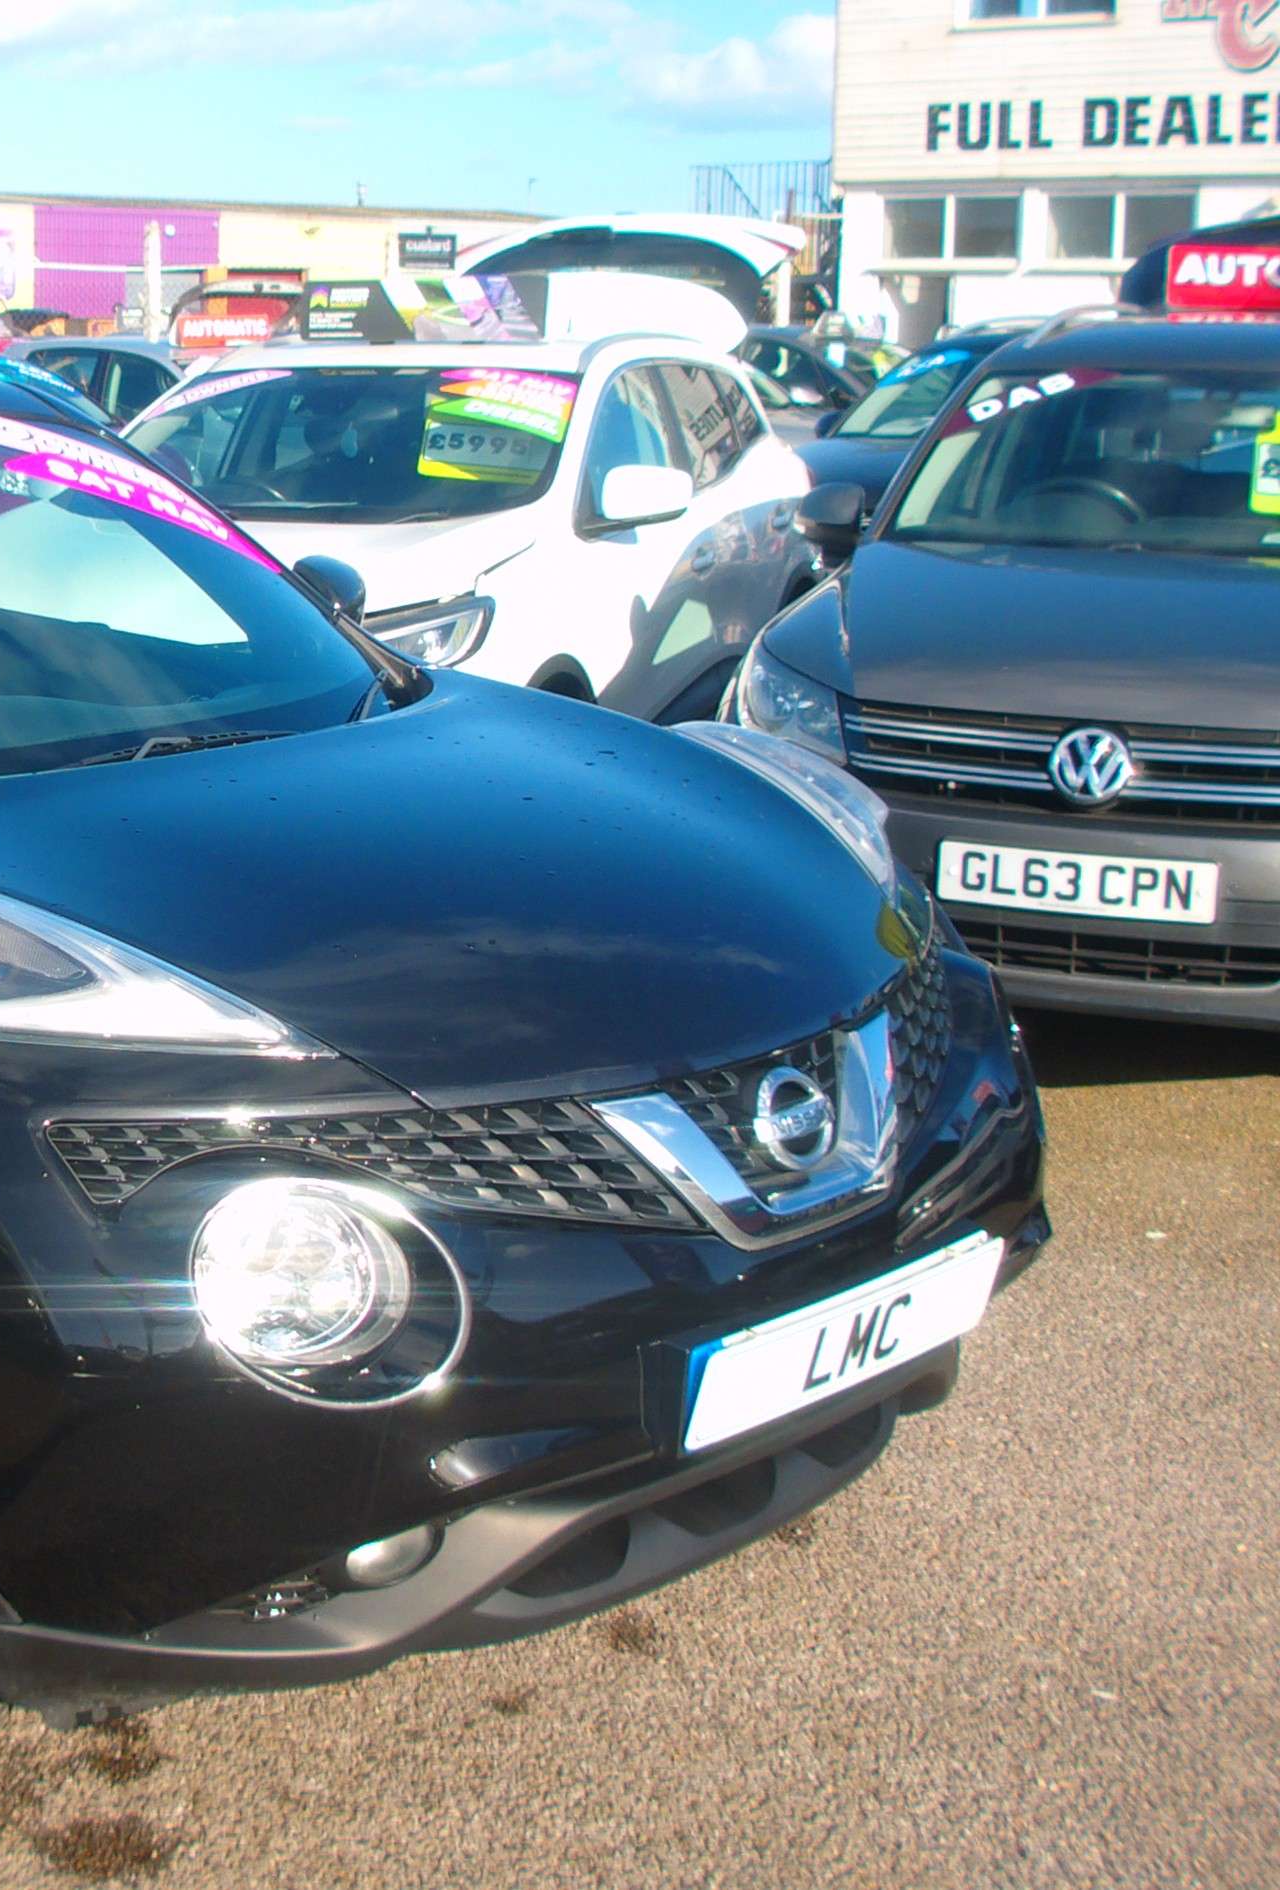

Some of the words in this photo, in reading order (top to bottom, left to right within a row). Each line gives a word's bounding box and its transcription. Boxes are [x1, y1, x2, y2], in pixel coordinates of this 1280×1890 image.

[926, 99, 1053, 152] FULL
[1081, 92, 1280, 147] DEALE
[182, 318, 269, 338] AUTOMATIC
[967, 372, 1075, 423] DAB
[428, 431, 531, 457] £5995
[45, 458, 135, 499] SAT
[147, 492, 228, 541] NAV
[960, 850, 1082, 902] GL63
[1098, 864, 1194, 911] CPN
[802, 1293, 911, 1393] LMC
